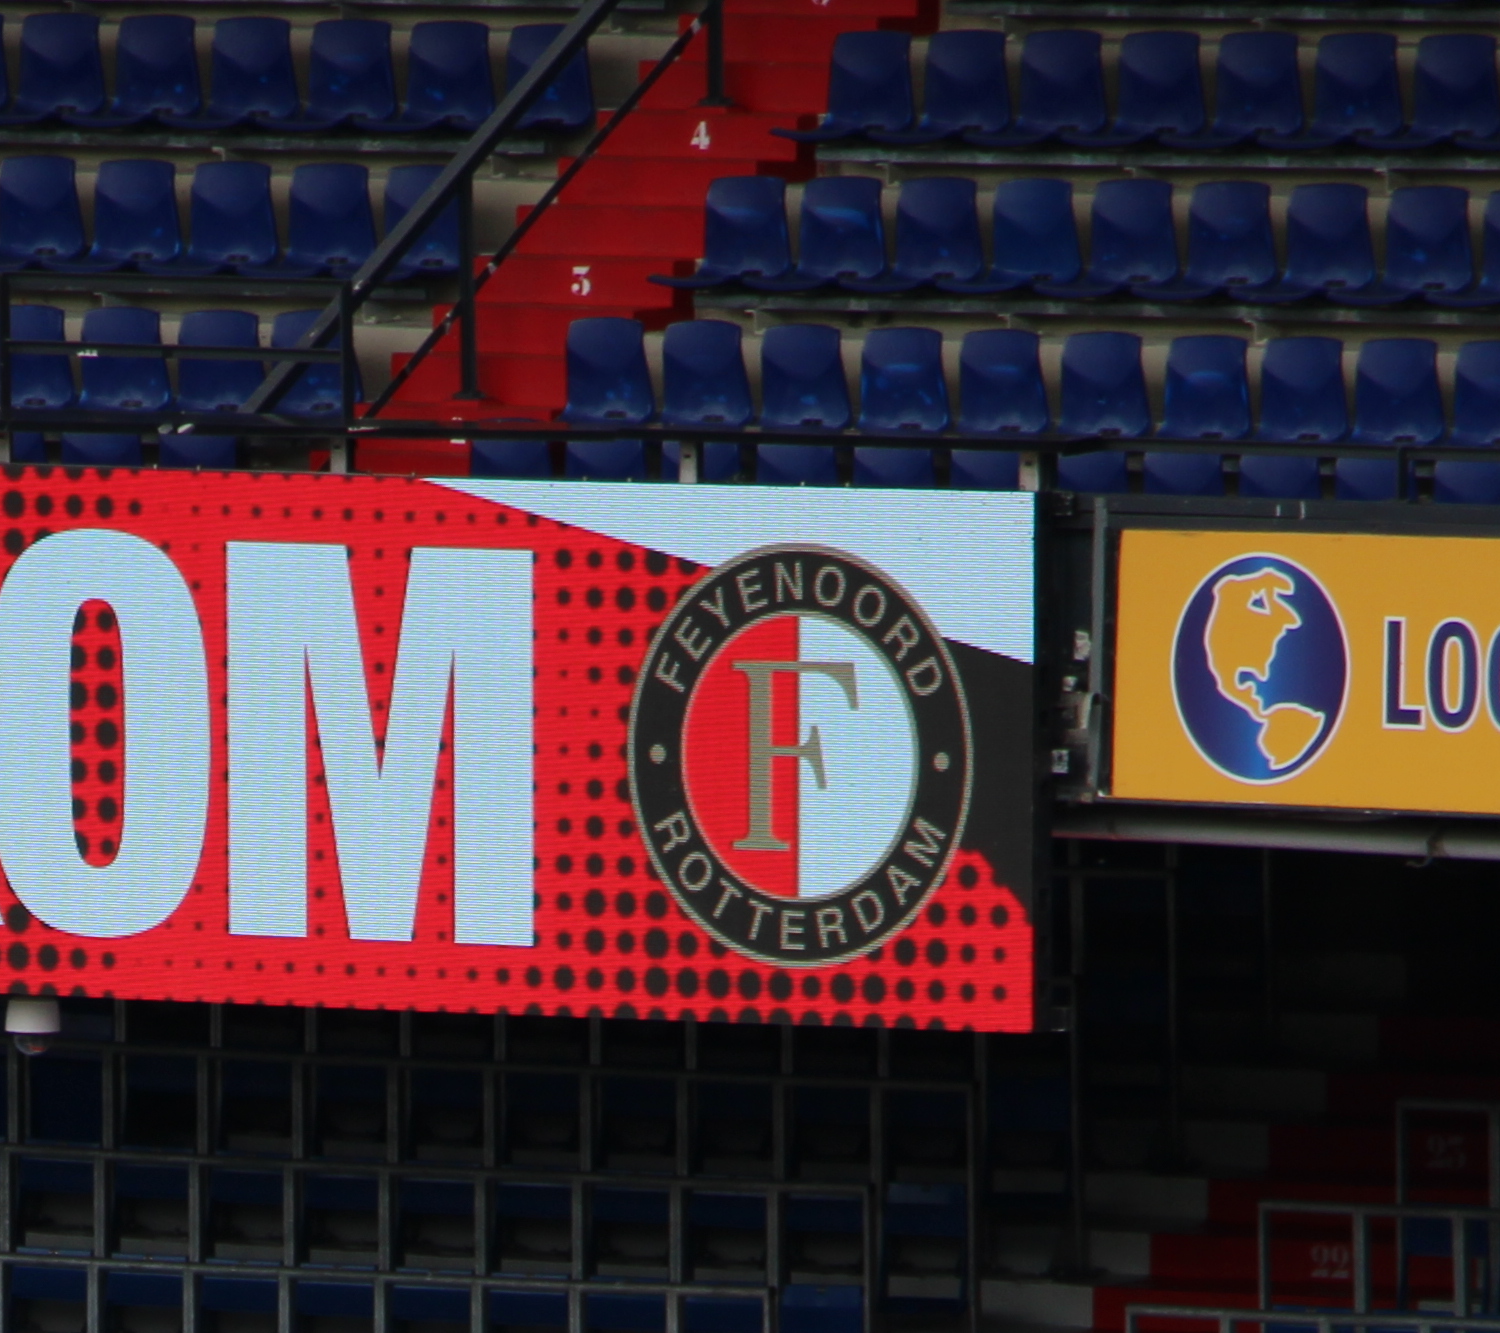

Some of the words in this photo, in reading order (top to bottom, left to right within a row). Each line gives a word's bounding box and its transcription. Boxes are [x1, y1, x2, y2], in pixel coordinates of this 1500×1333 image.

[690, 121, 711, 150] 4
[571, 266, 592, 296] 3
[656, 560, 943, 698] FEYENOORD
[732, 659, 860, 852] F
[653, 811, 946, 951] ROTTERDAM
[1309, 1242, 1350, 1280] 22
